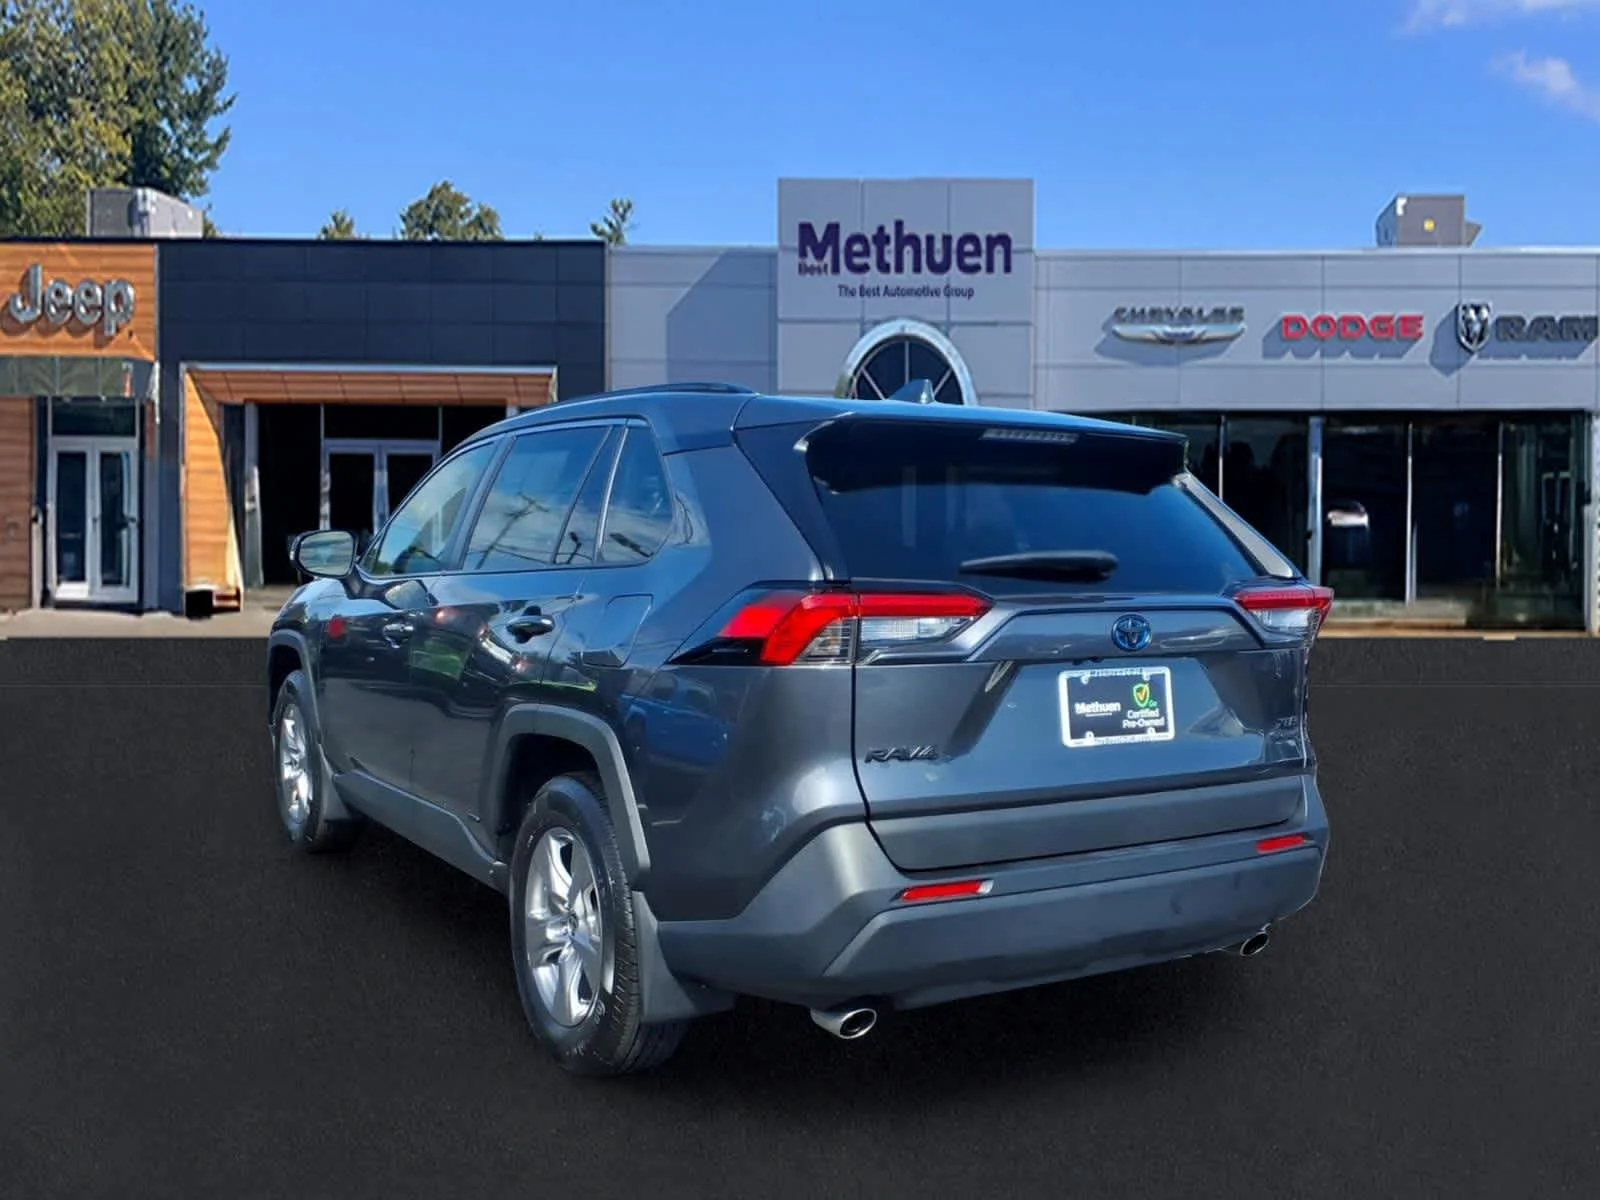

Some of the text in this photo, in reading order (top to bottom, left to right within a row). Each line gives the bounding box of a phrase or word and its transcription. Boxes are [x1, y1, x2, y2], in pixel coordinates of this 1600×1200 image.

[798, 220, 1012, 275] Methuen
[9, 263, 135, 336] Jeep
[838, 285, 974, 300] The Best Automotive Group
[1281, 315, 1424, 340] DODGE
[1496, 315, 1598, 341] RAM
[1075, 701, 1121, 715] Methuen
[864, 744, 937, 763] RAV4
